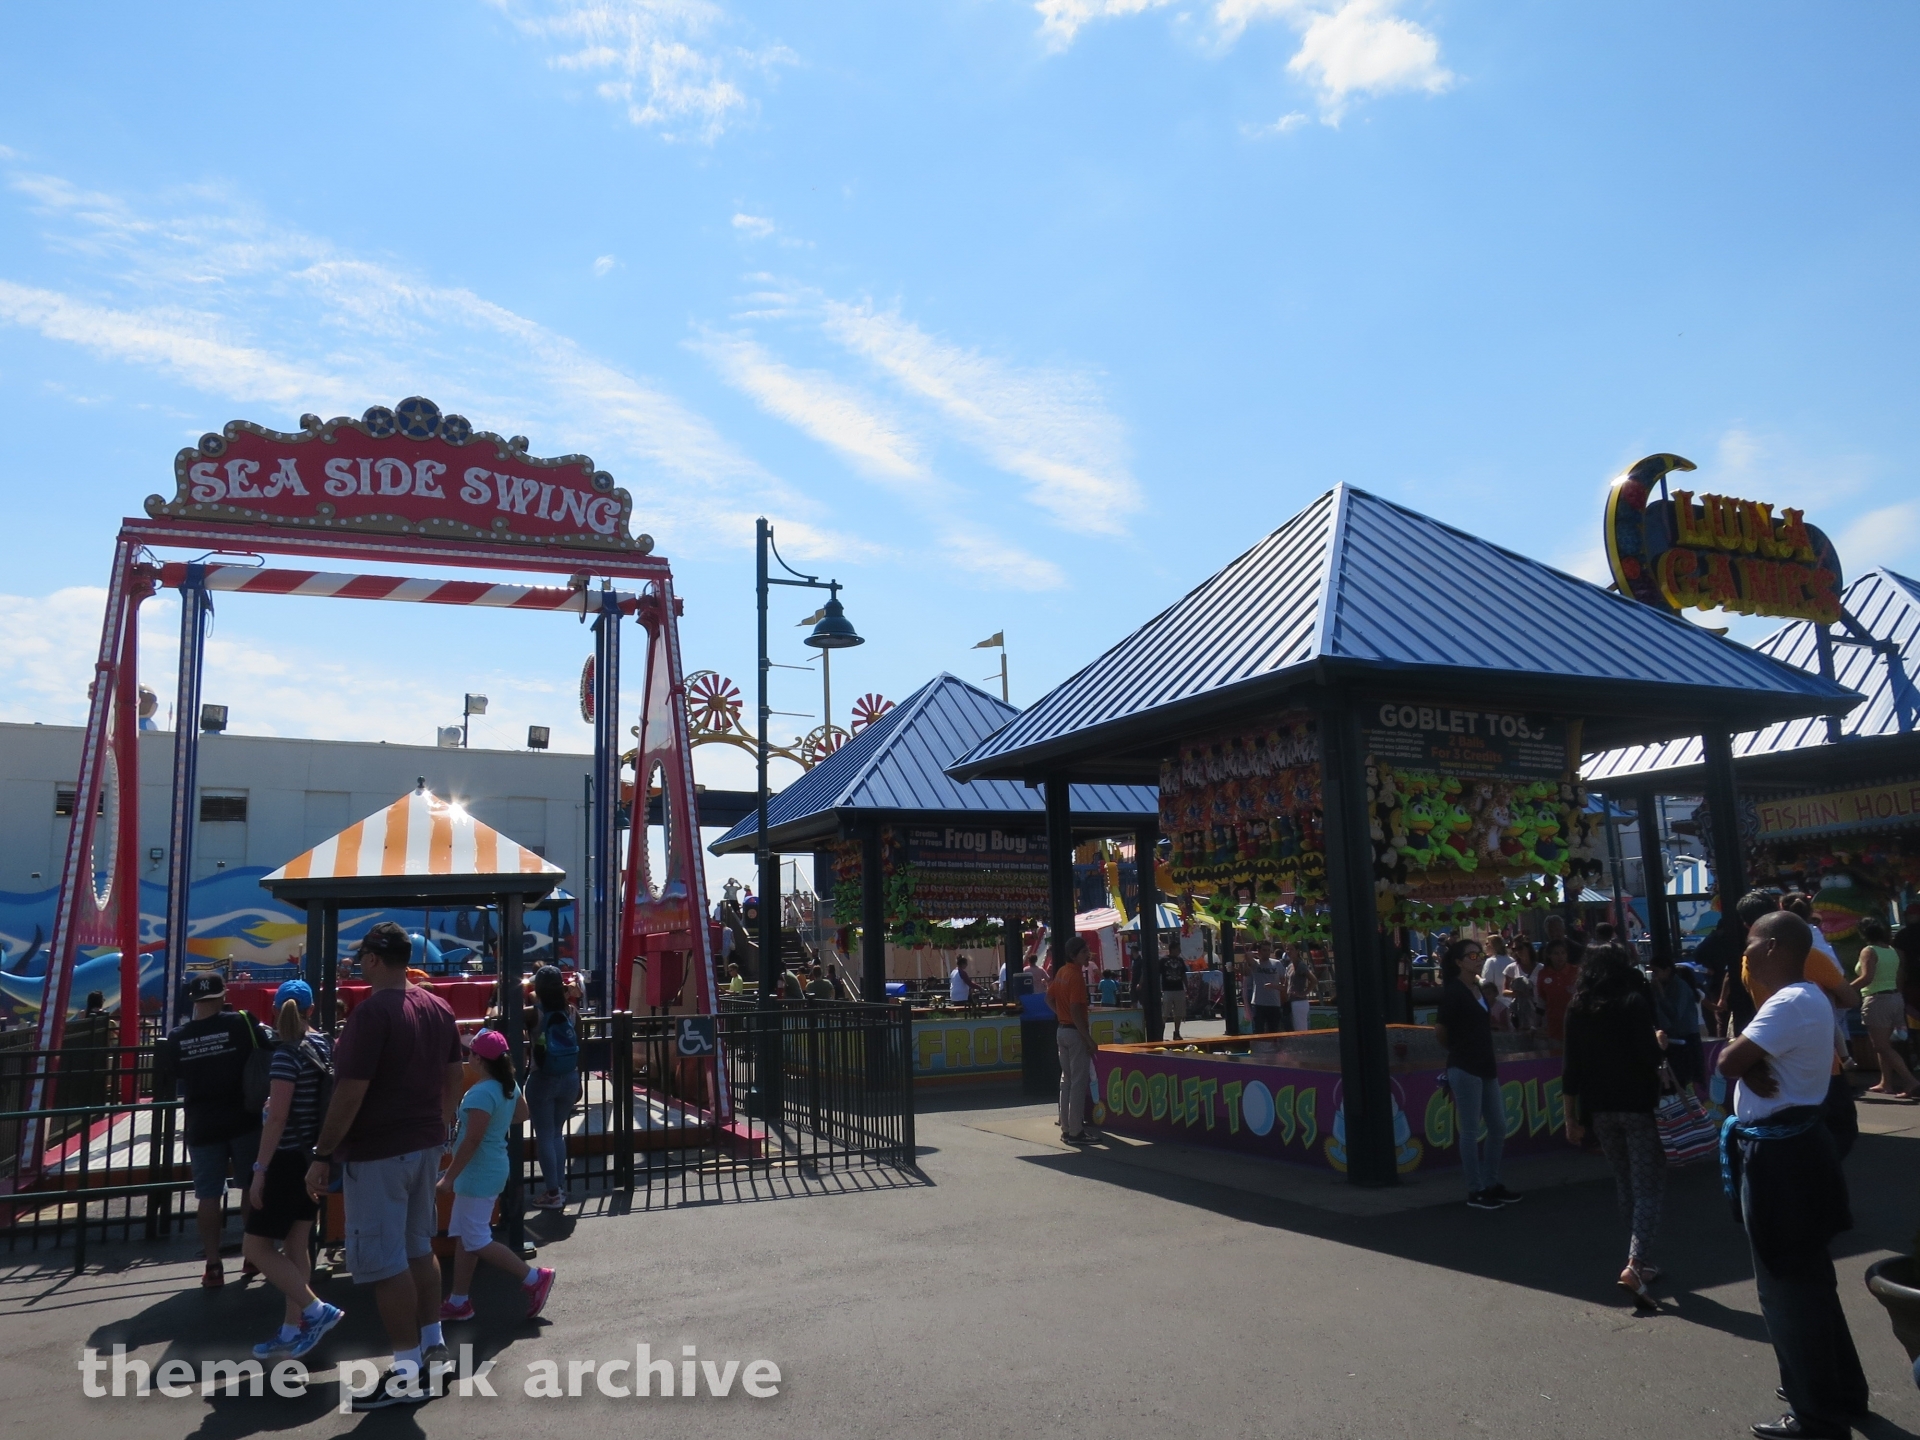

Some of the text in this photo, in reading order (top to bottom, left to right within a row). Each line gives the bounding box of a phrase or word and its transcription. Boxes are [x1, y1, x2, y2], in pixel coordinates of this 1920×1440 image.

[189, 457, 622, 535] SEA SIDE SWING
[1669, 488, 1819, 563] LUNA
[1656, 548, 1842, 626] GAMES
[1379, 704, 1479, 734] GOBLET
[1448, 735, 1486, 749] 2 Balls
[1431, 746, 1451, 760] For
[1463, 749, 1503, 763] Credits
[1761, 787, 1920, 832] FISHIN' HOLE
[945, 828, 1027, 853] Frog Buy
[918, 1025, 1022, 1071] FROG
[1106, 1066, 1318, 1150] GOBLET TOSS
[1424, 1075, 1580, 1150] GBLE
